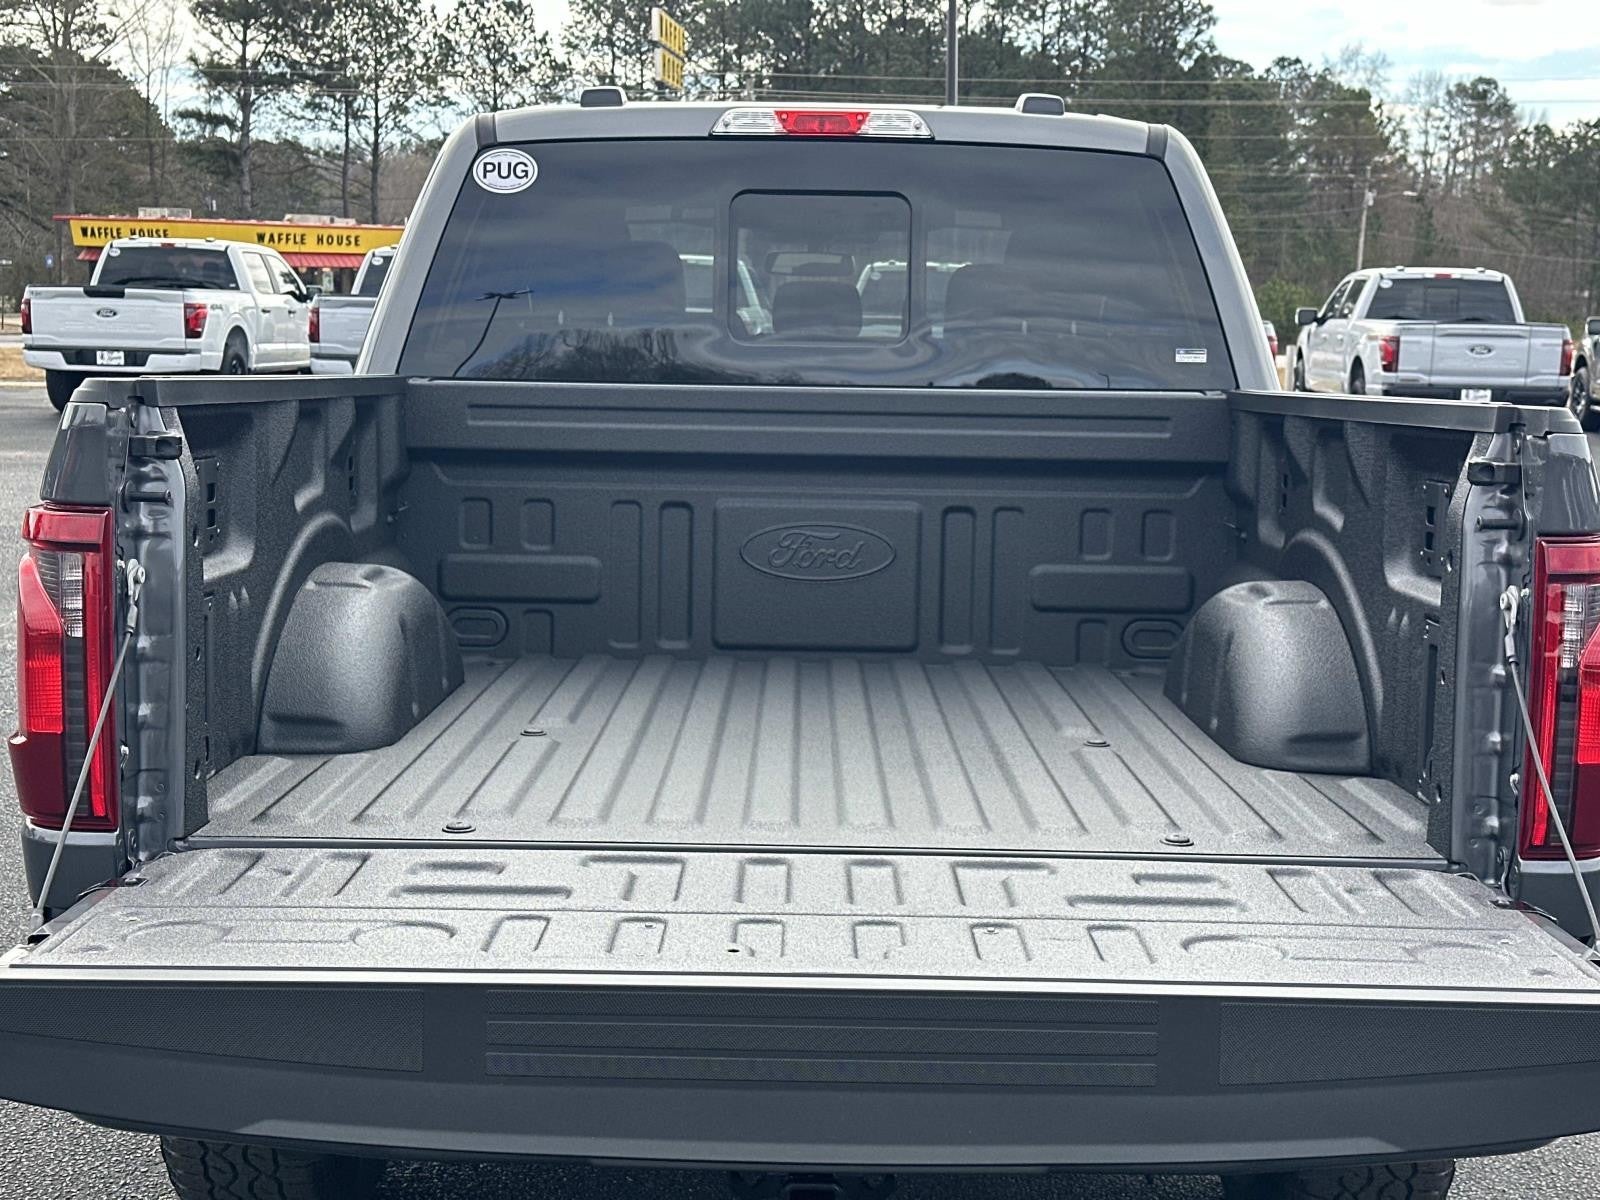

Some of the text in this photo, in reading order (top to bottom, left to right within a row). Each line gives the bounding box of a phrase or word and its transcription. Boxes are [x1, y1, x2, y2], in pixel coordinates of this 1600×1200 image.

[482, 161, 529, 179] PUG
[80, 226, 169, 239] WAFFLE HOUSE
[256, 232, 361, 247] WAFFLE HOUSE
[768, 529, 865, 569] Ford
